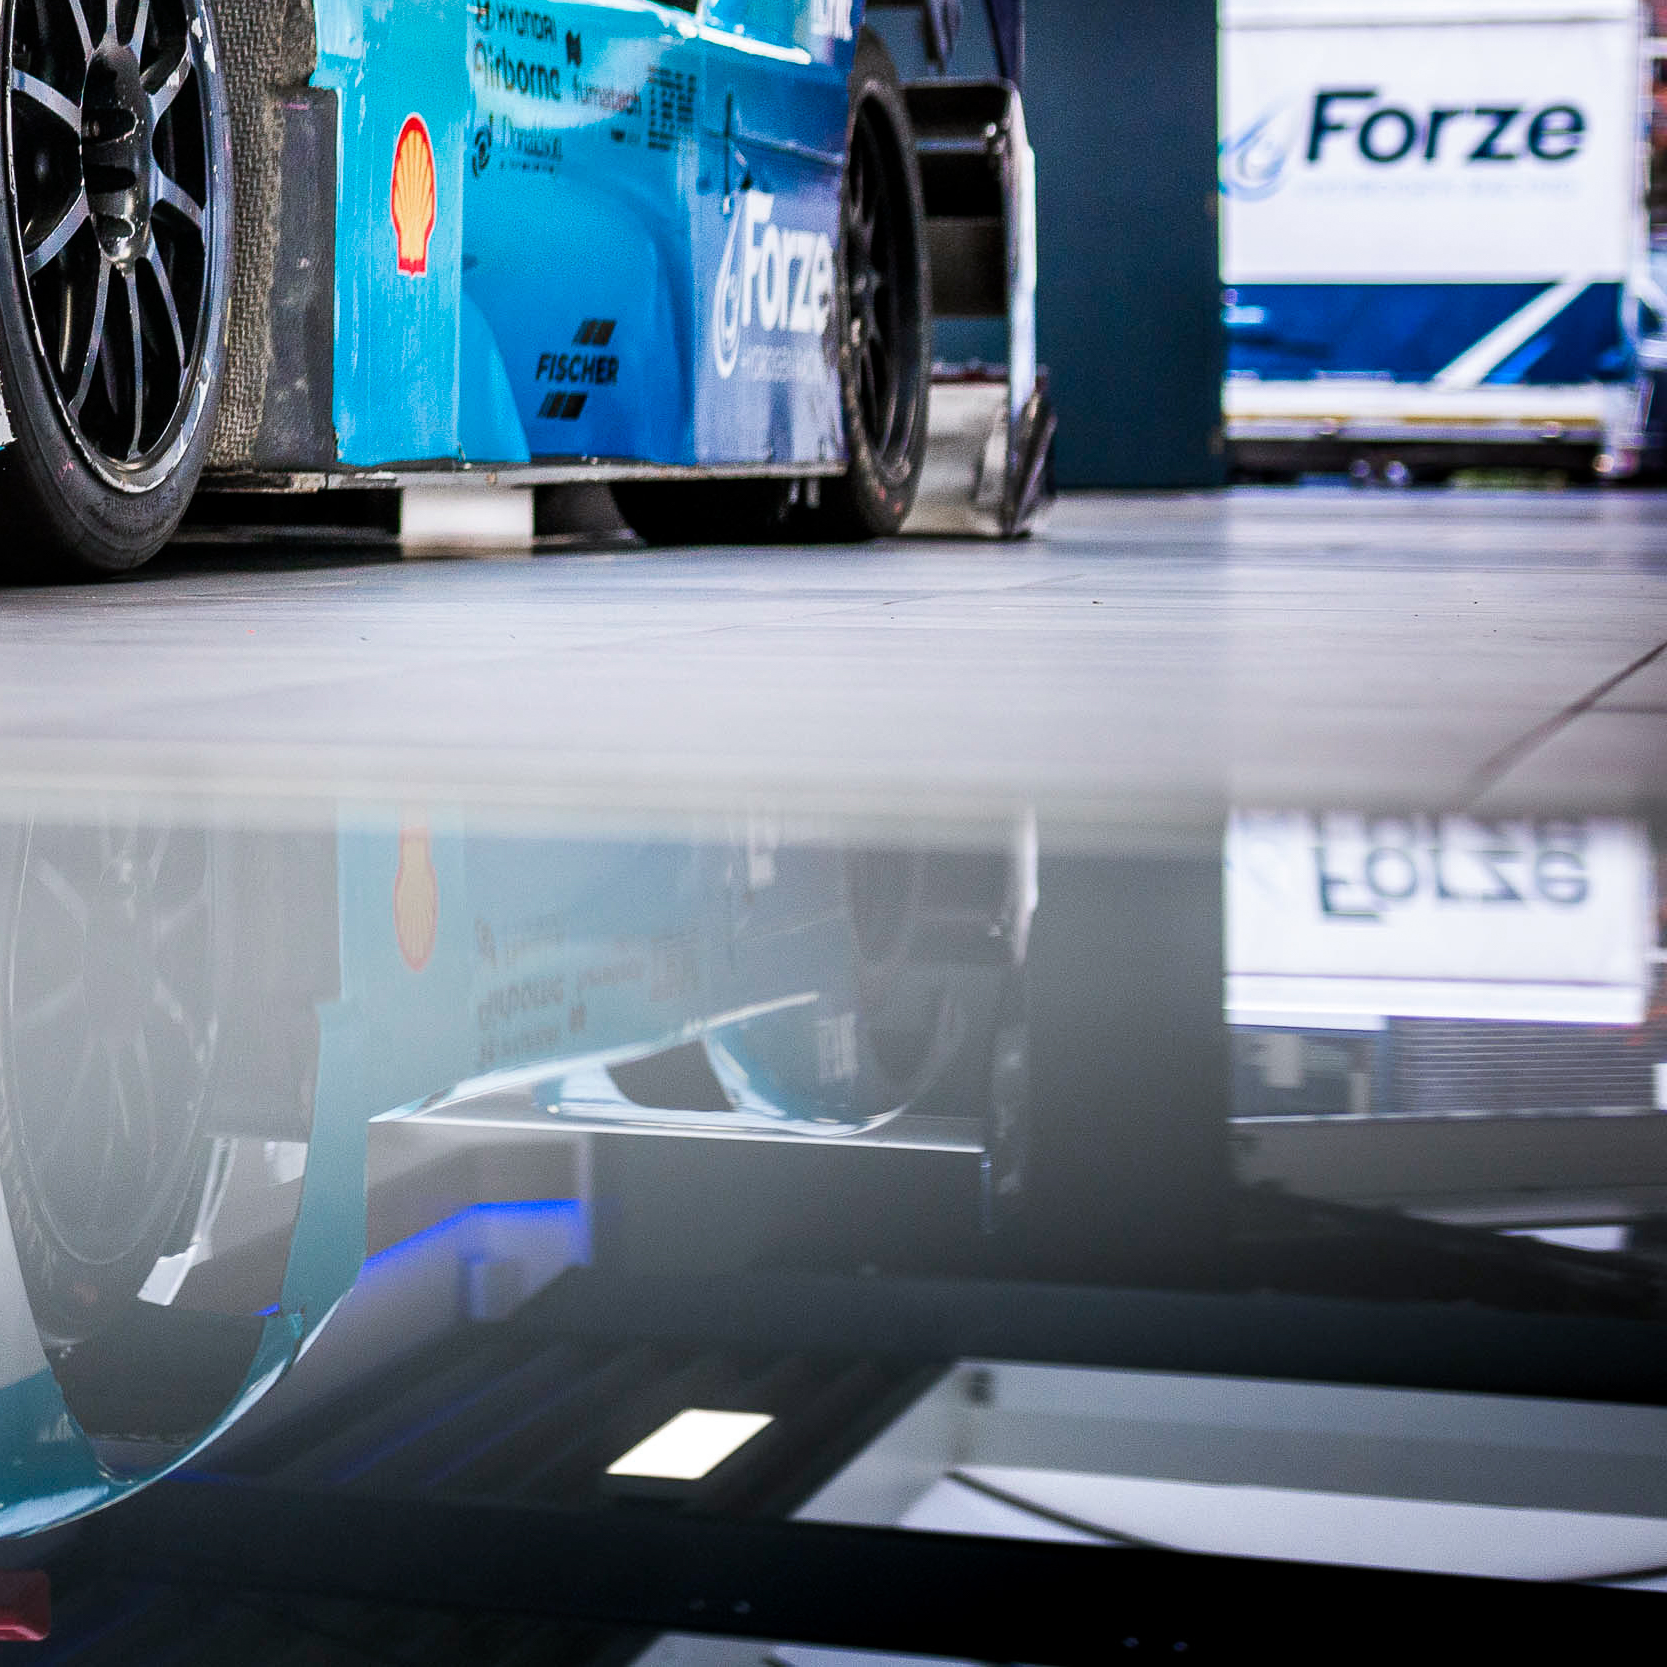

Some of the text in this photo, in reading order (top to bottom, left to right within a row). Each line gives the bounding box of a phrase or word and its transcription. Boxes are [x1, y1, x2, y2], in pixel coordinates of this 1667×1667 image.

[1305, 88, 1585, 163] Forze
[741, 190, 834, 334] Forze
[535, 352, 619, 386] FISCHER
